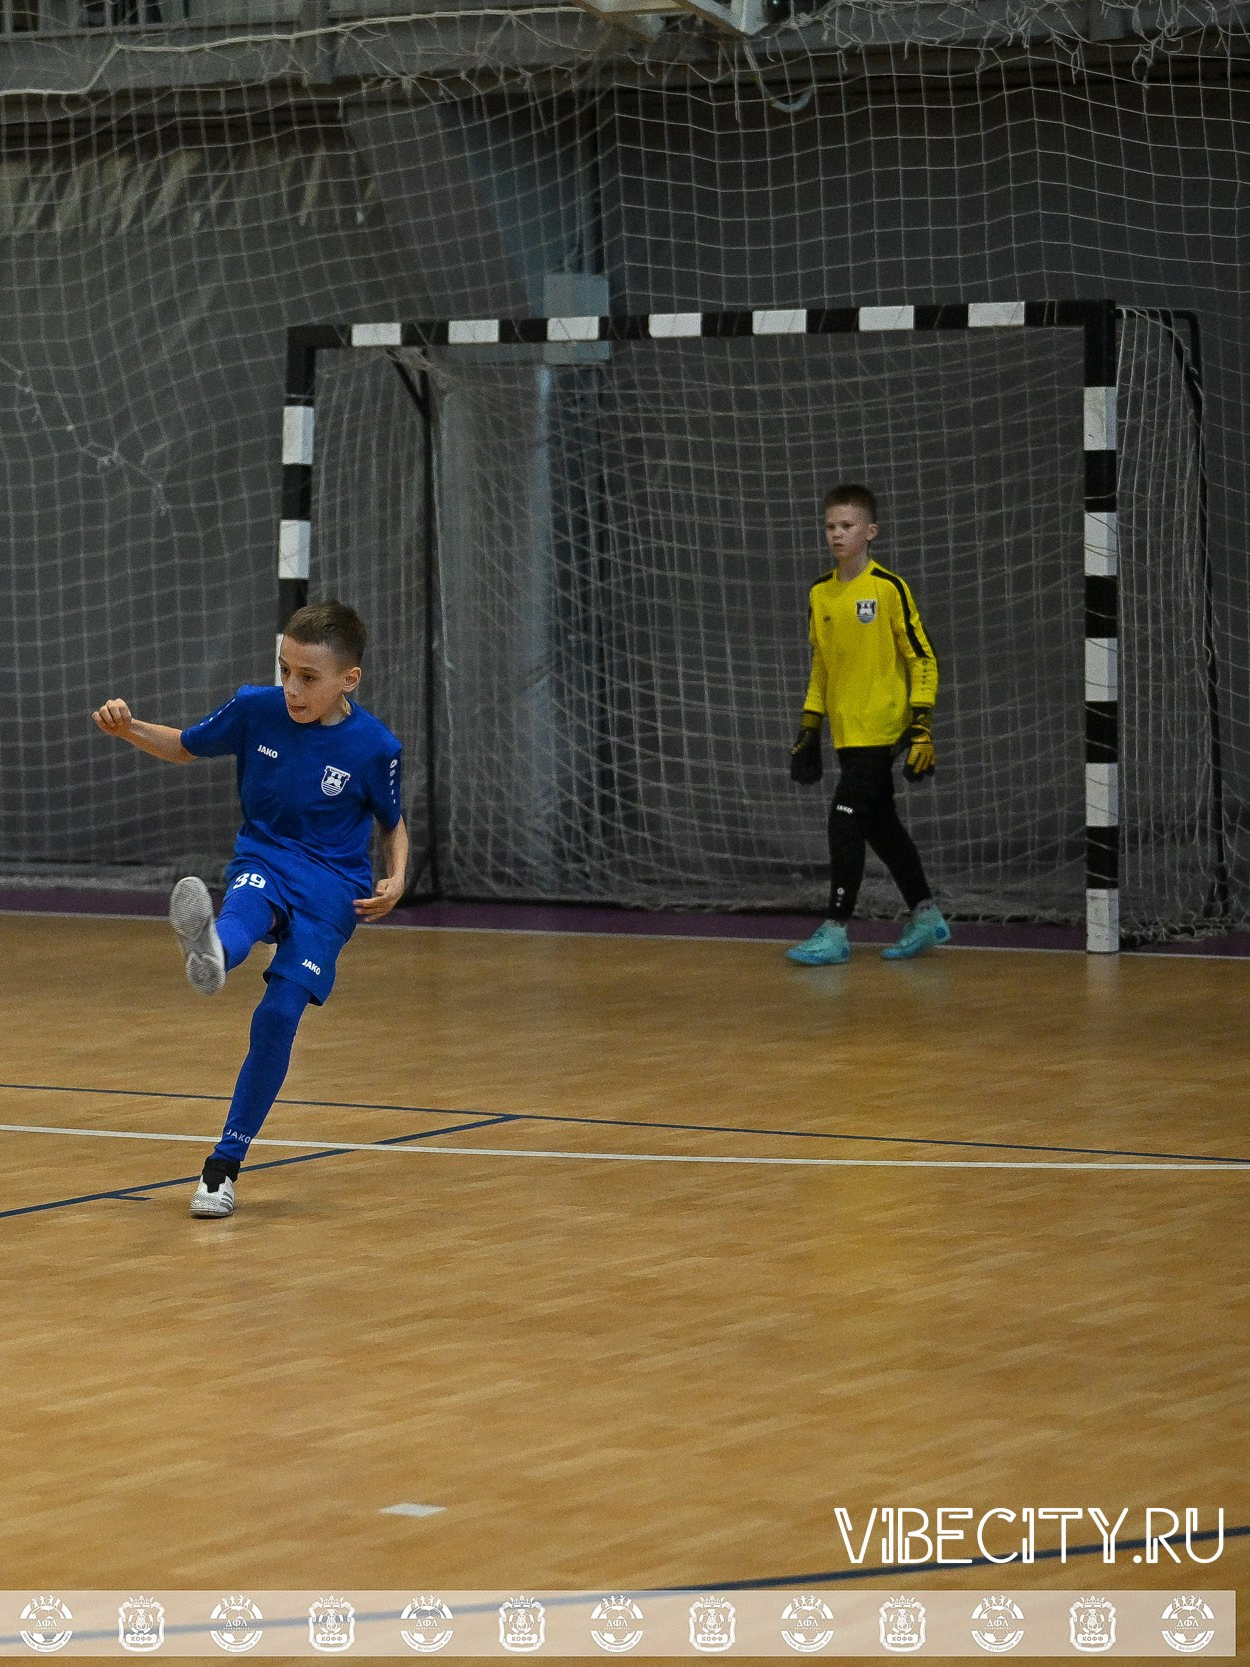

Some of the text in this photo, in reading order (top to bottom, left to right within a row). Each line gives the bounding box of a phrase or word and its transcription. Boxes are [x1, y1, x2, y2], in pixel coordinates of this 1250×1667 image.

[257, 744, 278, 759] JAKO
[232, 872, 267, 890] 39
[301, 958, 321, 976] JAKO
[226, 1128, 251, 1144] JAKO
